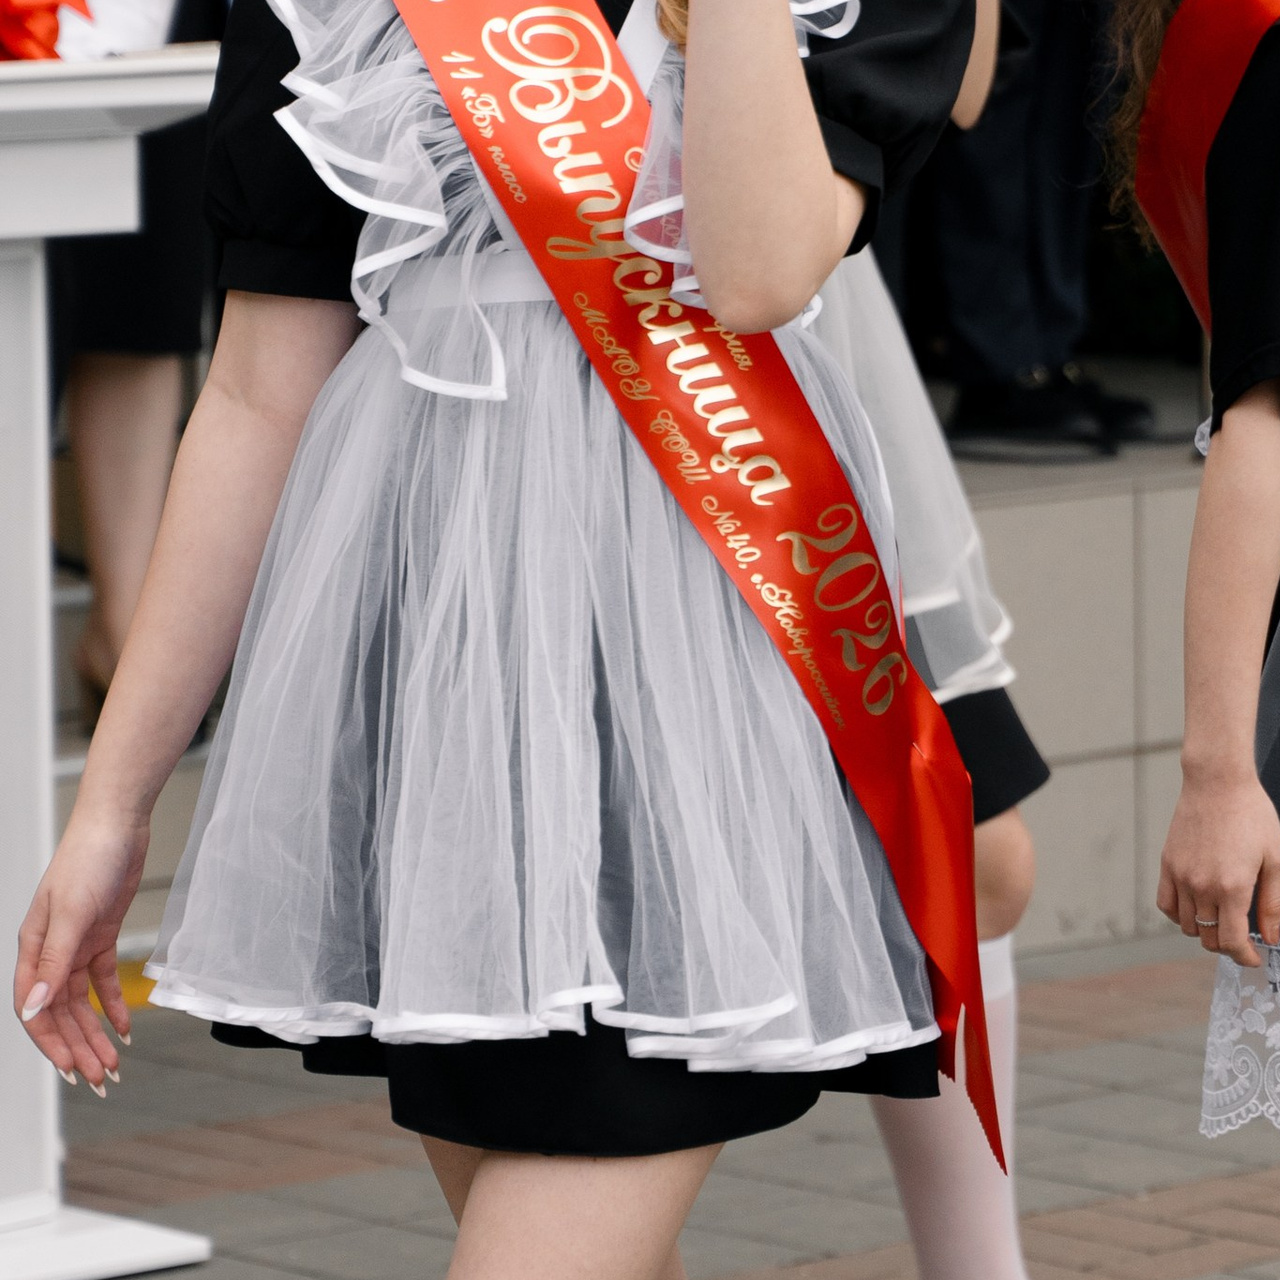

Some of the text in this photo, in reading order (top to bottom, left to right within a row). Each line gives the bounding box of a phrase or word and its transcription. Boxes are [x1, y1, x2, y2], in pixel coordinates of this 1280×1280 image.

[442, 51, 484, 79] 11
[488, 145, 528, 205] класс
[481, 6, 907, 716] Выпускница 2026
[573, 292, 660, 402] МАОУ
